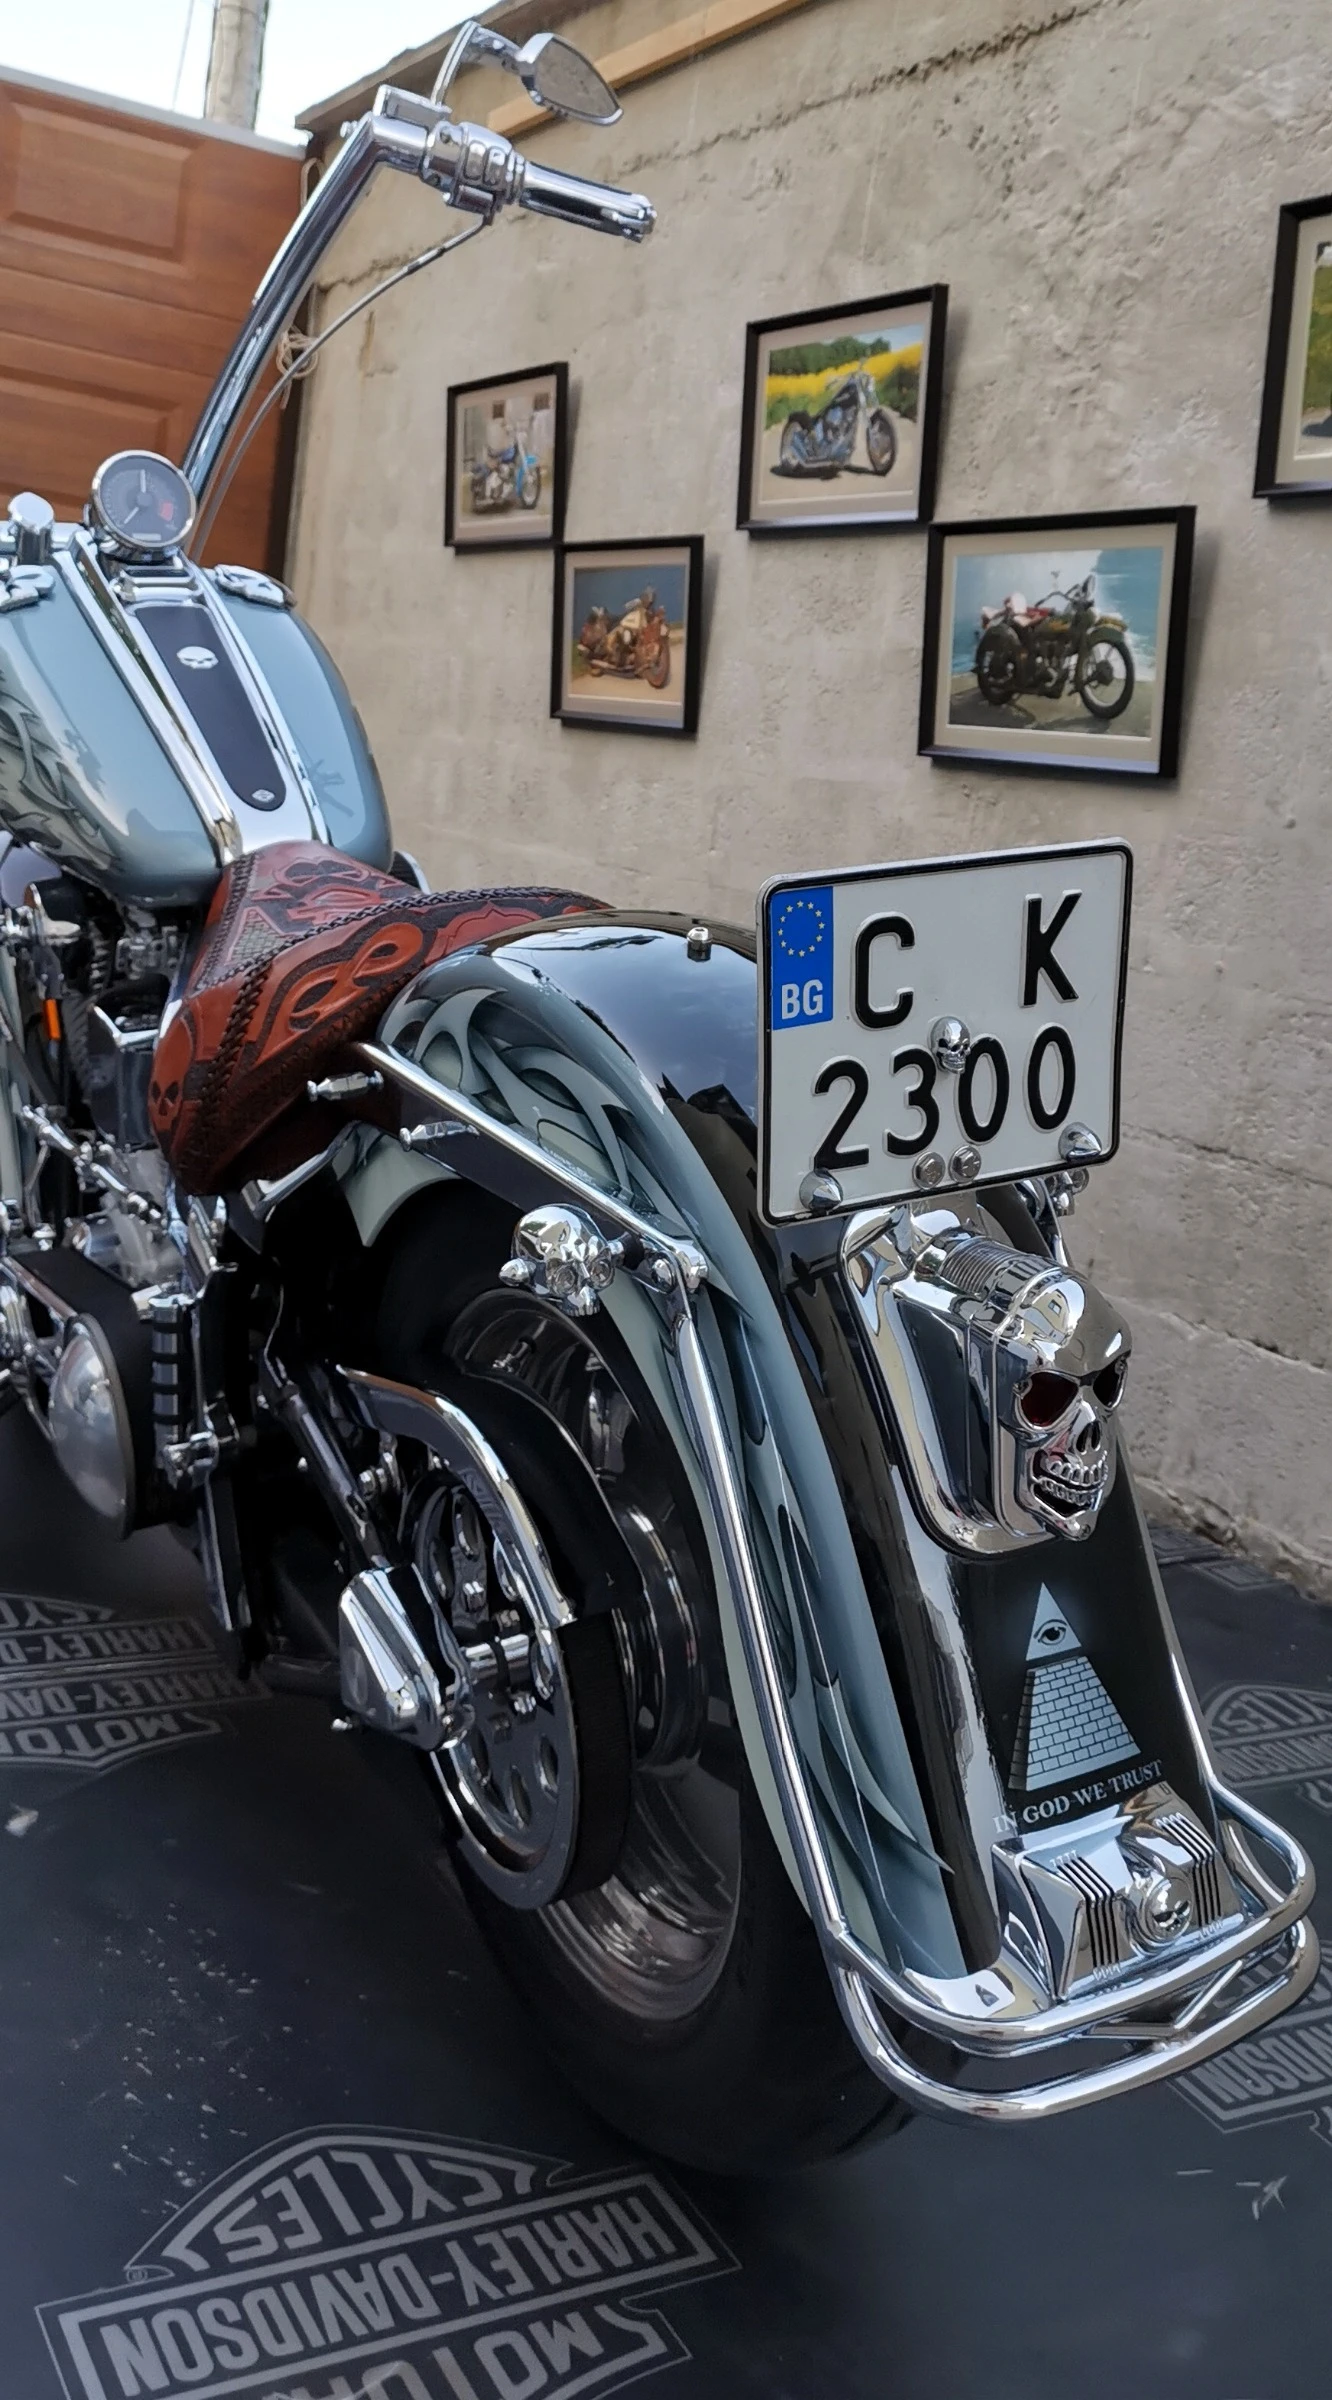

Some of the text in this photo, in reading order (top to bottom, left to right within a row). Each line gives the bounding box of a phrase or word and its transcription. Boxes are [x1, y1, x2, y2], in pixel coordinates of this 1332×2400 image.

[780, 978, 823, 1020] BG
[852, 889, 1083, 1029] C K
[811, 1023, 1077, 1171] 2300
[992, 1759, 1162, 1834] IN GOD WE TRUST
[213, 2150, 502, 2262] CYCLES
[99, 2196, 678, 2397] HARLEY-DAVIDSON
